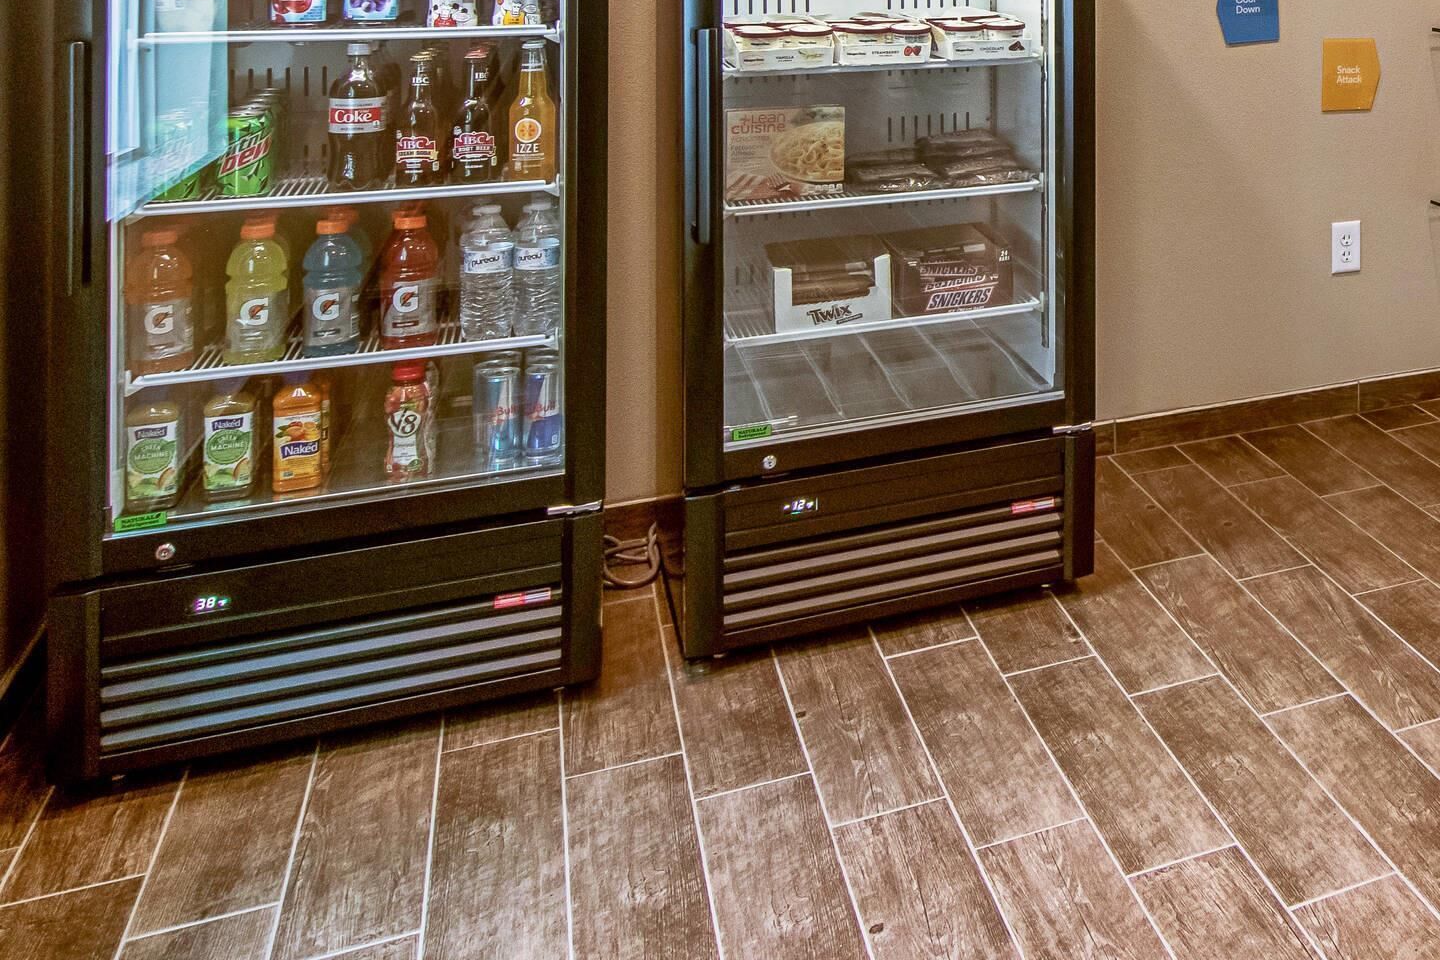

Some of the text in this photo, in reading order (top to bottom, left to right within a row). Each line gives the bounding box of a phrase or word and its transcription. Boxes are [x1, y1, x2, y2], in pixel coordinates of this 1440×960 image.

[1236, 5, 1261, 14] Down
[1336, 65, 1361, 74] Snack
[412, 76, 429, 84] IBC
[1336, 74, 1362, 84] Attack
[334, 109, 372, 123] Coke
[731, 123, 785, 134] cuisine
[403, 140, 424, 150] IBC
[463, 135, 484, 145] IBC
[516, 144, 539, 153] IZZE
[471, 255, 500, 267] pureau
[393, 285, 418, 312] G
[929, 288, 991, 309] SNICKERS
[240, 298, 269, 325] G
[312, 293, 339, 320] G
[145, 304, 174, 334] G
[807, 304, 852, 325] Twix
[214, 418, 242, 429] Naked
[390, 412, 418, 434] V8
[210, 441, 245, 451] MACHINE
[284, 442, 318, 456] Naked
[195, 597, 215, 611] 38
